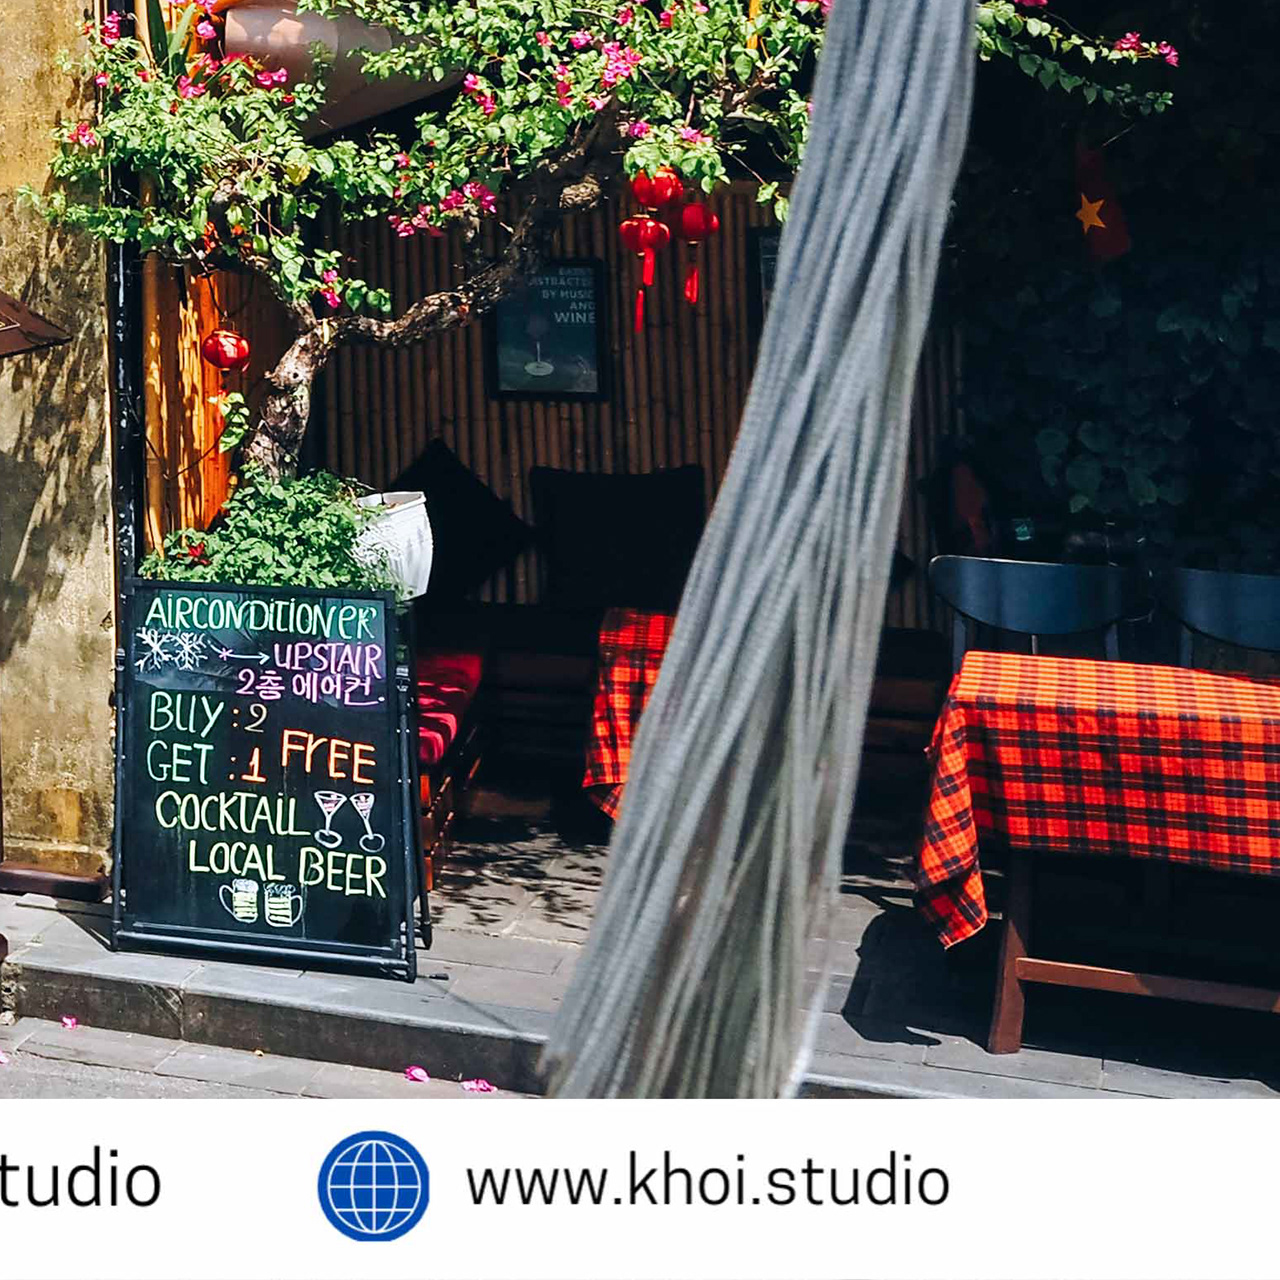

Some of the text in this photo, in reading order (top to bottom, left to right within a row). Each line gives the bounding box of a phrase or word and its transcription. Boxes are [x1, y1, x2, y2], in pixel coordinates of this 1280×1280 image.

[542, 289, 595, 299] BY MUSIC
[569, 301, 596, 310] AND
[554, 312, 596, 324] WINE
[146, 740, 214, 785] GET
[189, 840, 387, 898] LOCAL BEER
